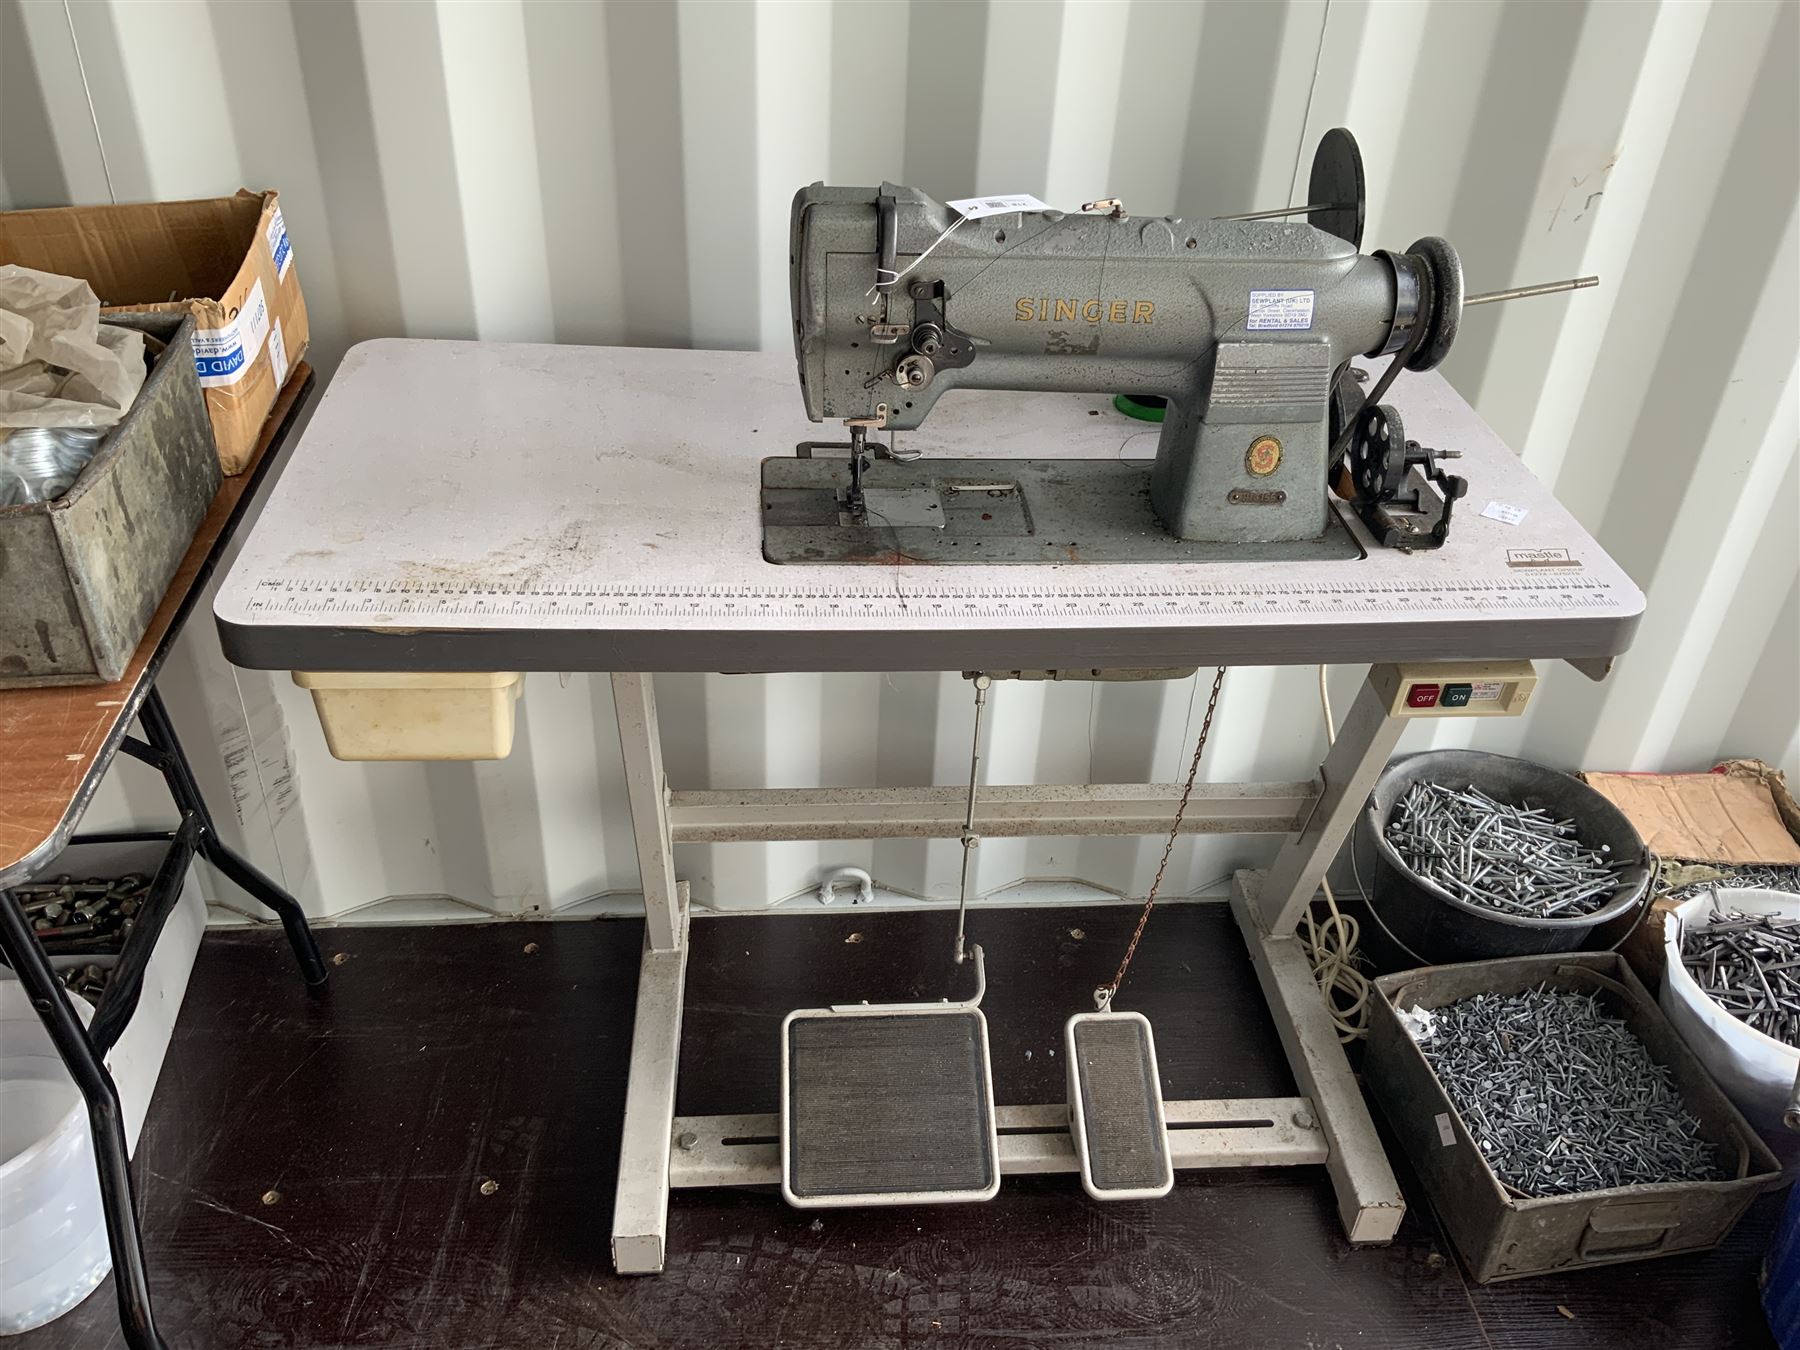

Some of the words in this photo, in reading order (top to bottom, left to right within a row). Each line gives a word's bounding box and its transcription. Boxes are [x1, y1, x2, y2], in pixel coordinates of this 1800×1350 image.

[1015, 297, 1155, 324] SINGER
[193, 341, 237, 356] www.david
[211, 350, 244, 373] DAVID
[1416, 694, 1435, 703] OFF
[1451, 694, 1467, 702] ON
